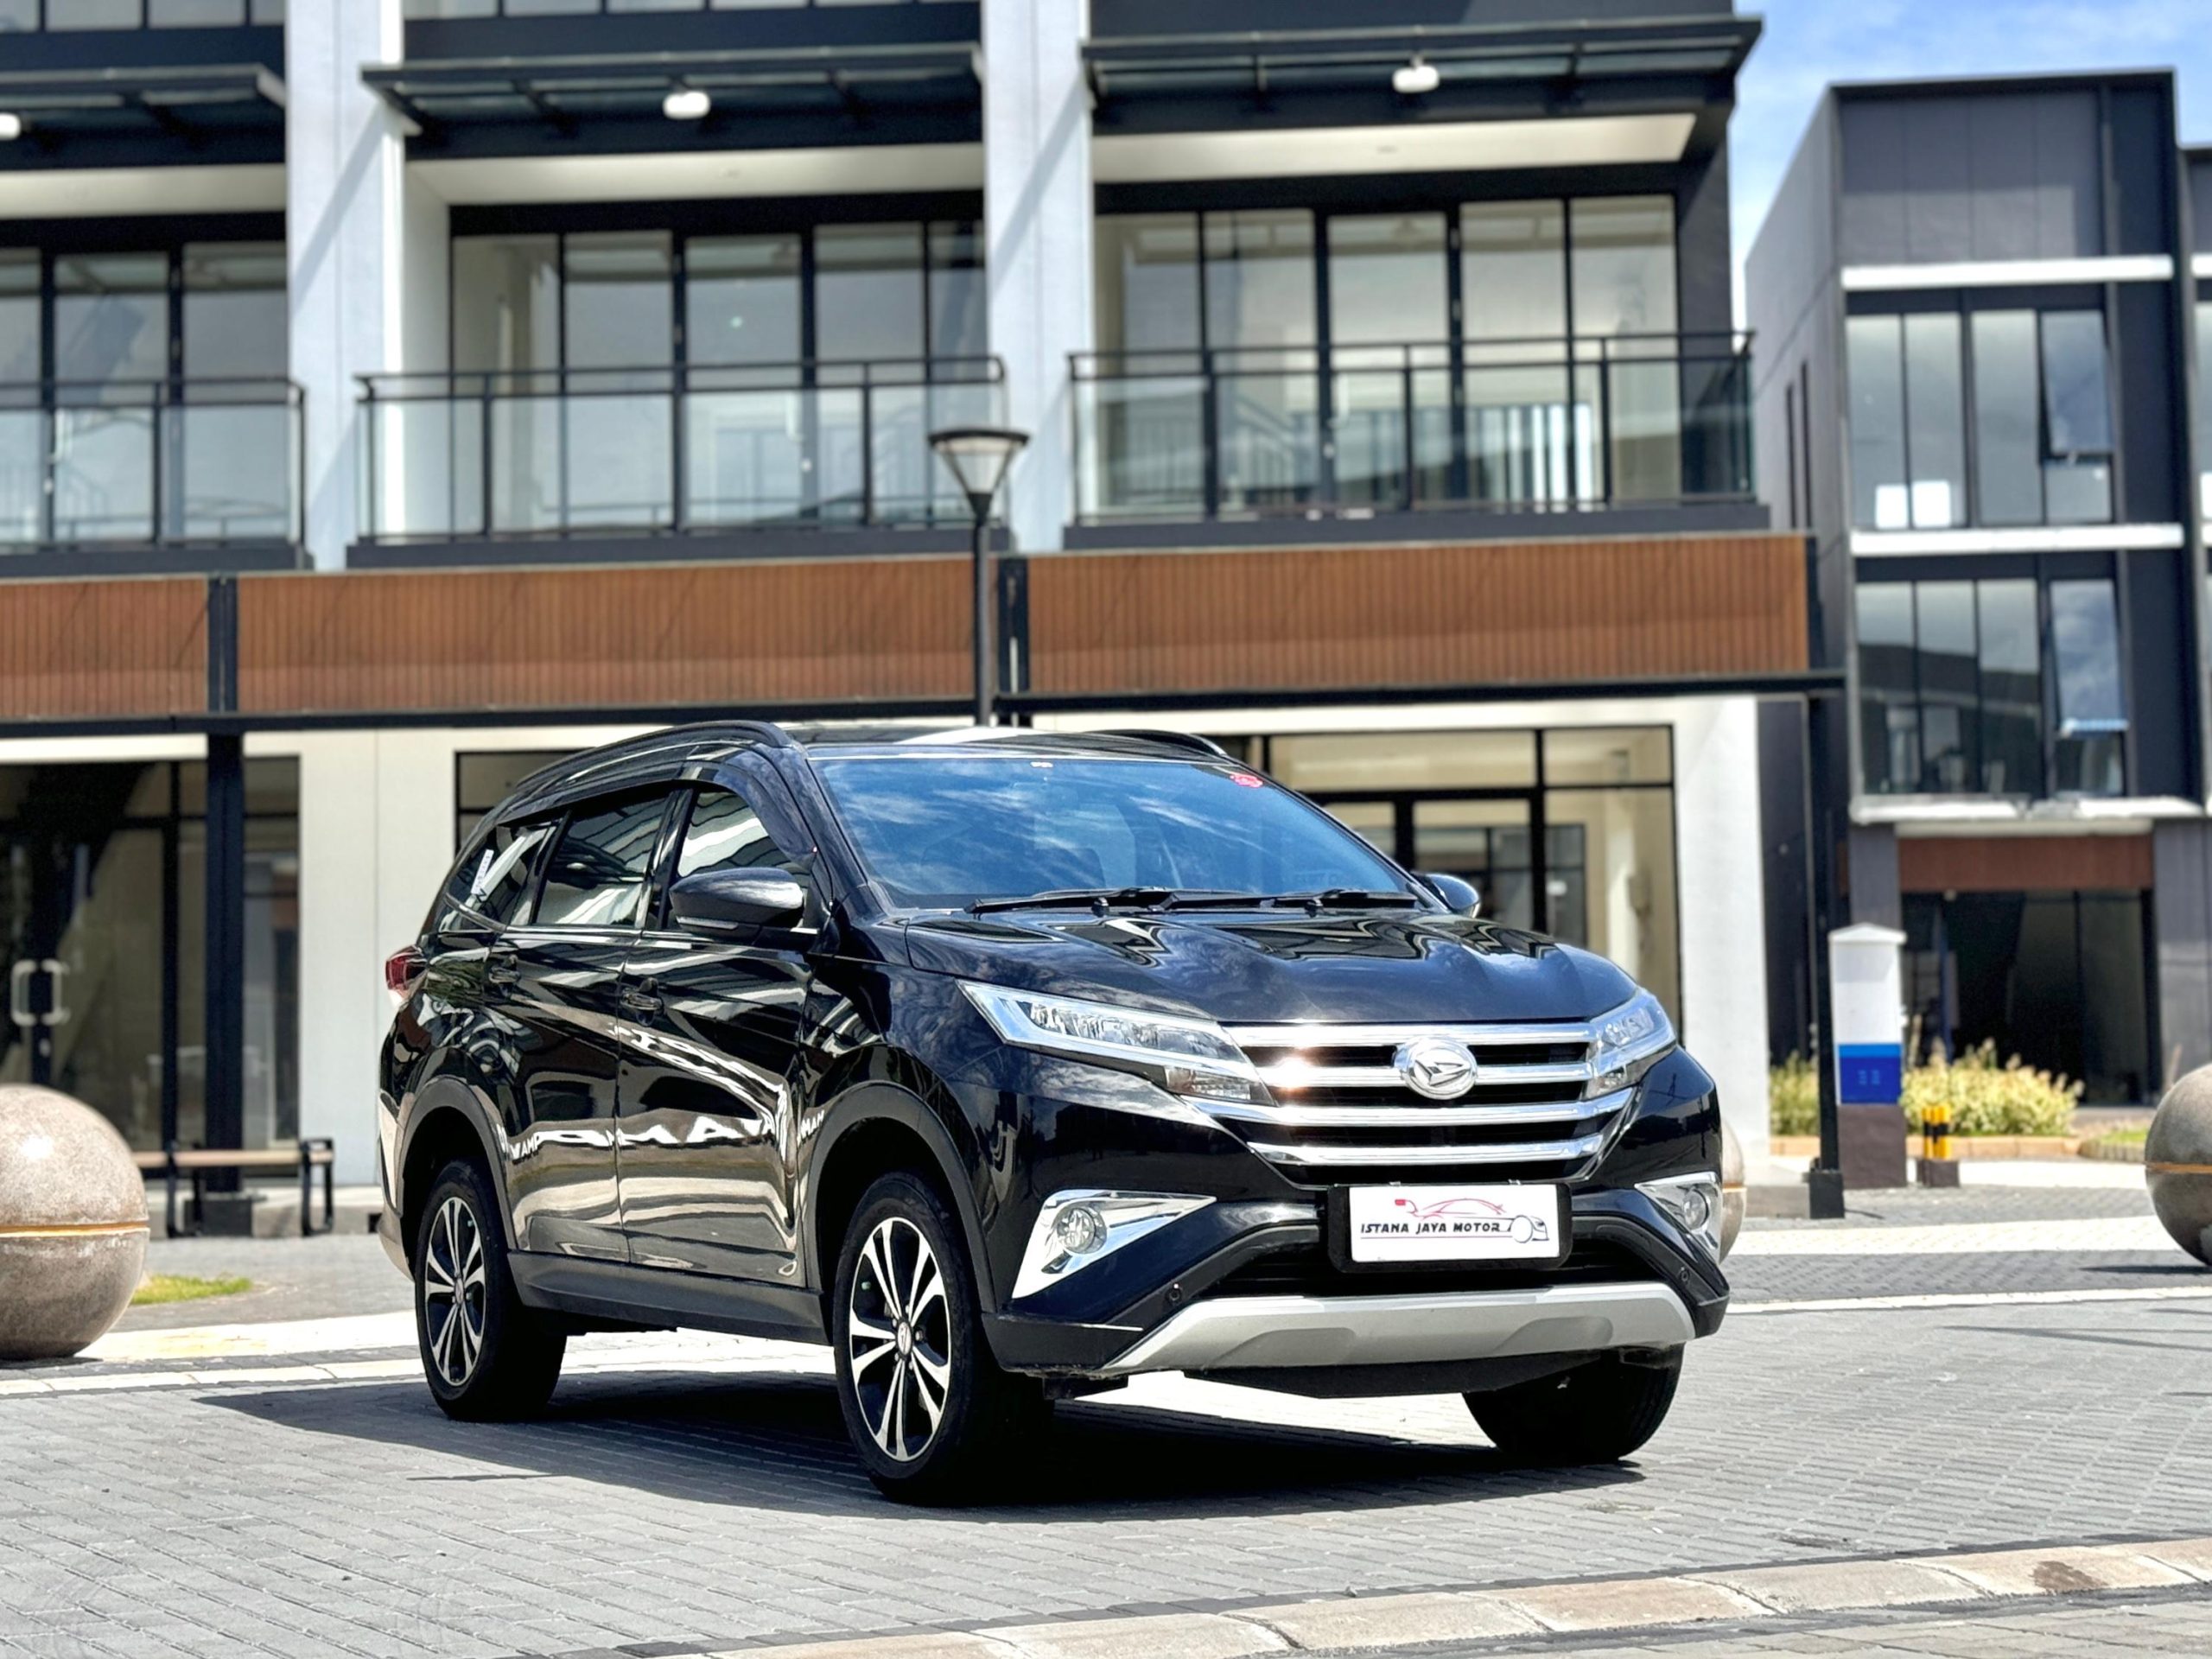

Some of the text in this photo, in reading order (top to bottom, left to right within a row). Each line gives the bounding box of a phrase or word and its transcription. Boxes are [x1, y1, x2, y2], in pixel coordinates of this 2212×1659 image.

[1360, 1223, 1500, 1234] ISTANA JAYA MOTOR
